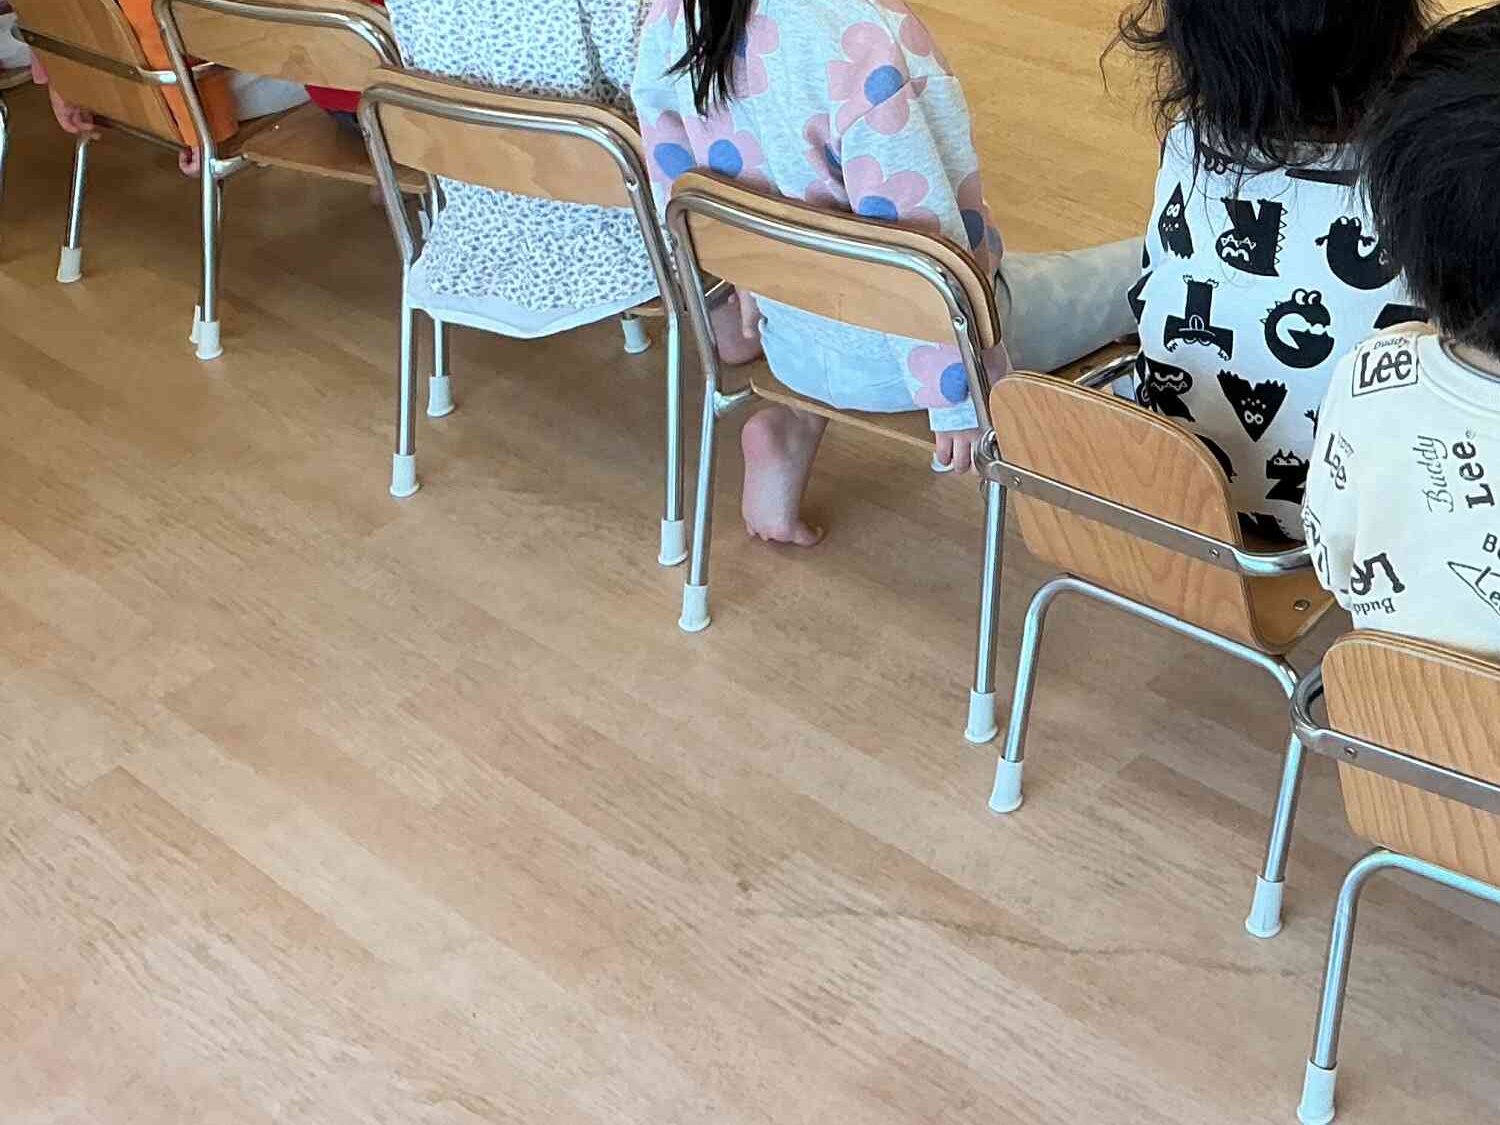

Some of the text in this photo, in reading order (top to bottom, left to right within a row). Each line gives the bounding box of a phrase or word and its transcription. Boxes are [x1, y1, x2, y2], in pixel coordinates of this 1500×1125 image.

[1359, 350, 1413, 389] Lee
[1412, 435, 1454, 513] Buddy
[1452, 440, 1495, 509] Lee
[1353, 597, 1396, 614] Budd
